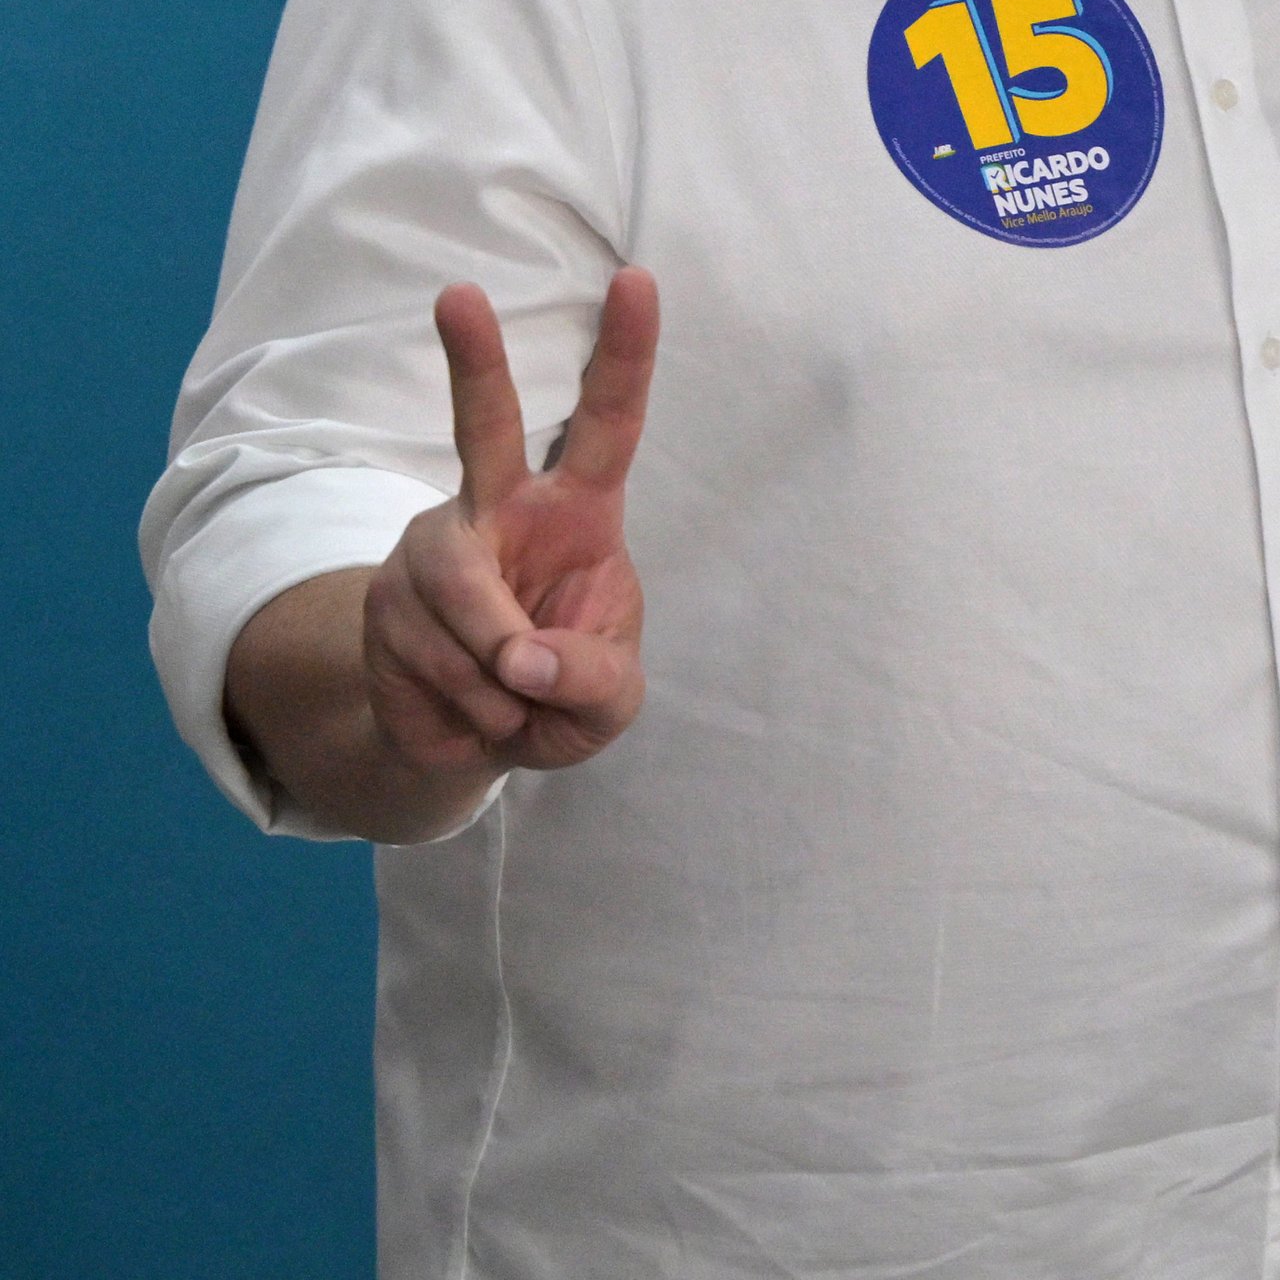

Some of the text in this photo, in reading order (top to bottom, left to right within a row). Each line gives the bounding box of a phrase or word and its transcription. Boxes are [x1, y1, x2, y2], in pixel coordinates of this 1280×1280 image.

[980, 148, 1026, 164] PREFEITO
[981, 146, 1110, 193] RICARDO
[993, 178, 1089, 217] NUNES
[1001, 217, 1025, 229] Vice
[1026, 210, 1057, 224] Mello
